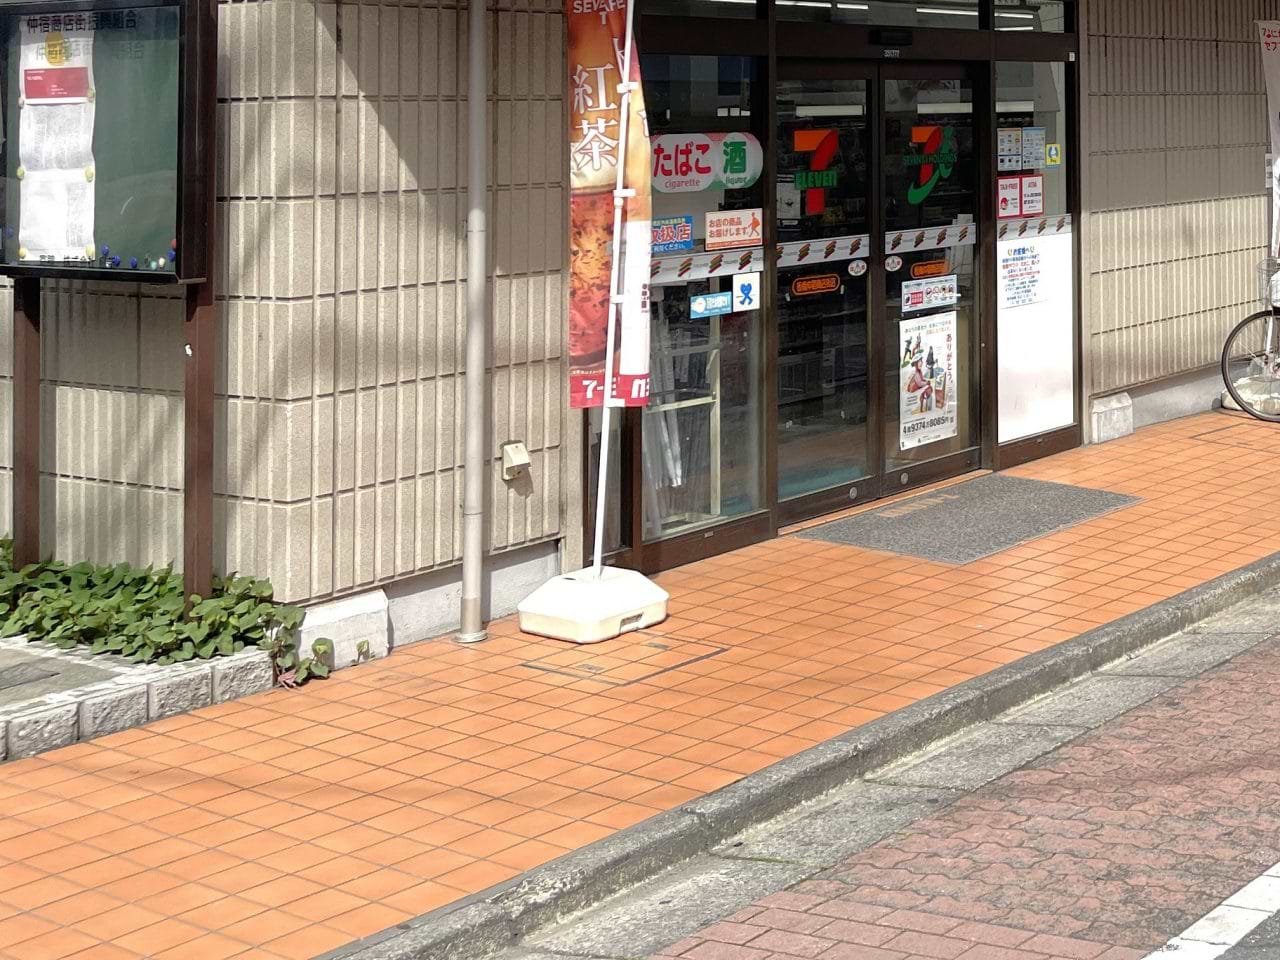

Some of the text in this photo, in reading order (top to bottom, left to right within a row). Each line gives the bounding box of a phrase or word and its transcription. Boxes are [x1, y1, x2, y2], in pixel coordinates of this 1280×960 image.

[573, 63, 619, 172] 紅茶
[654, 141, 747, 177] たばこ 酒
[664, 179, 700, 189] cigarette
[708, 217, 742, 228] お店の商品
